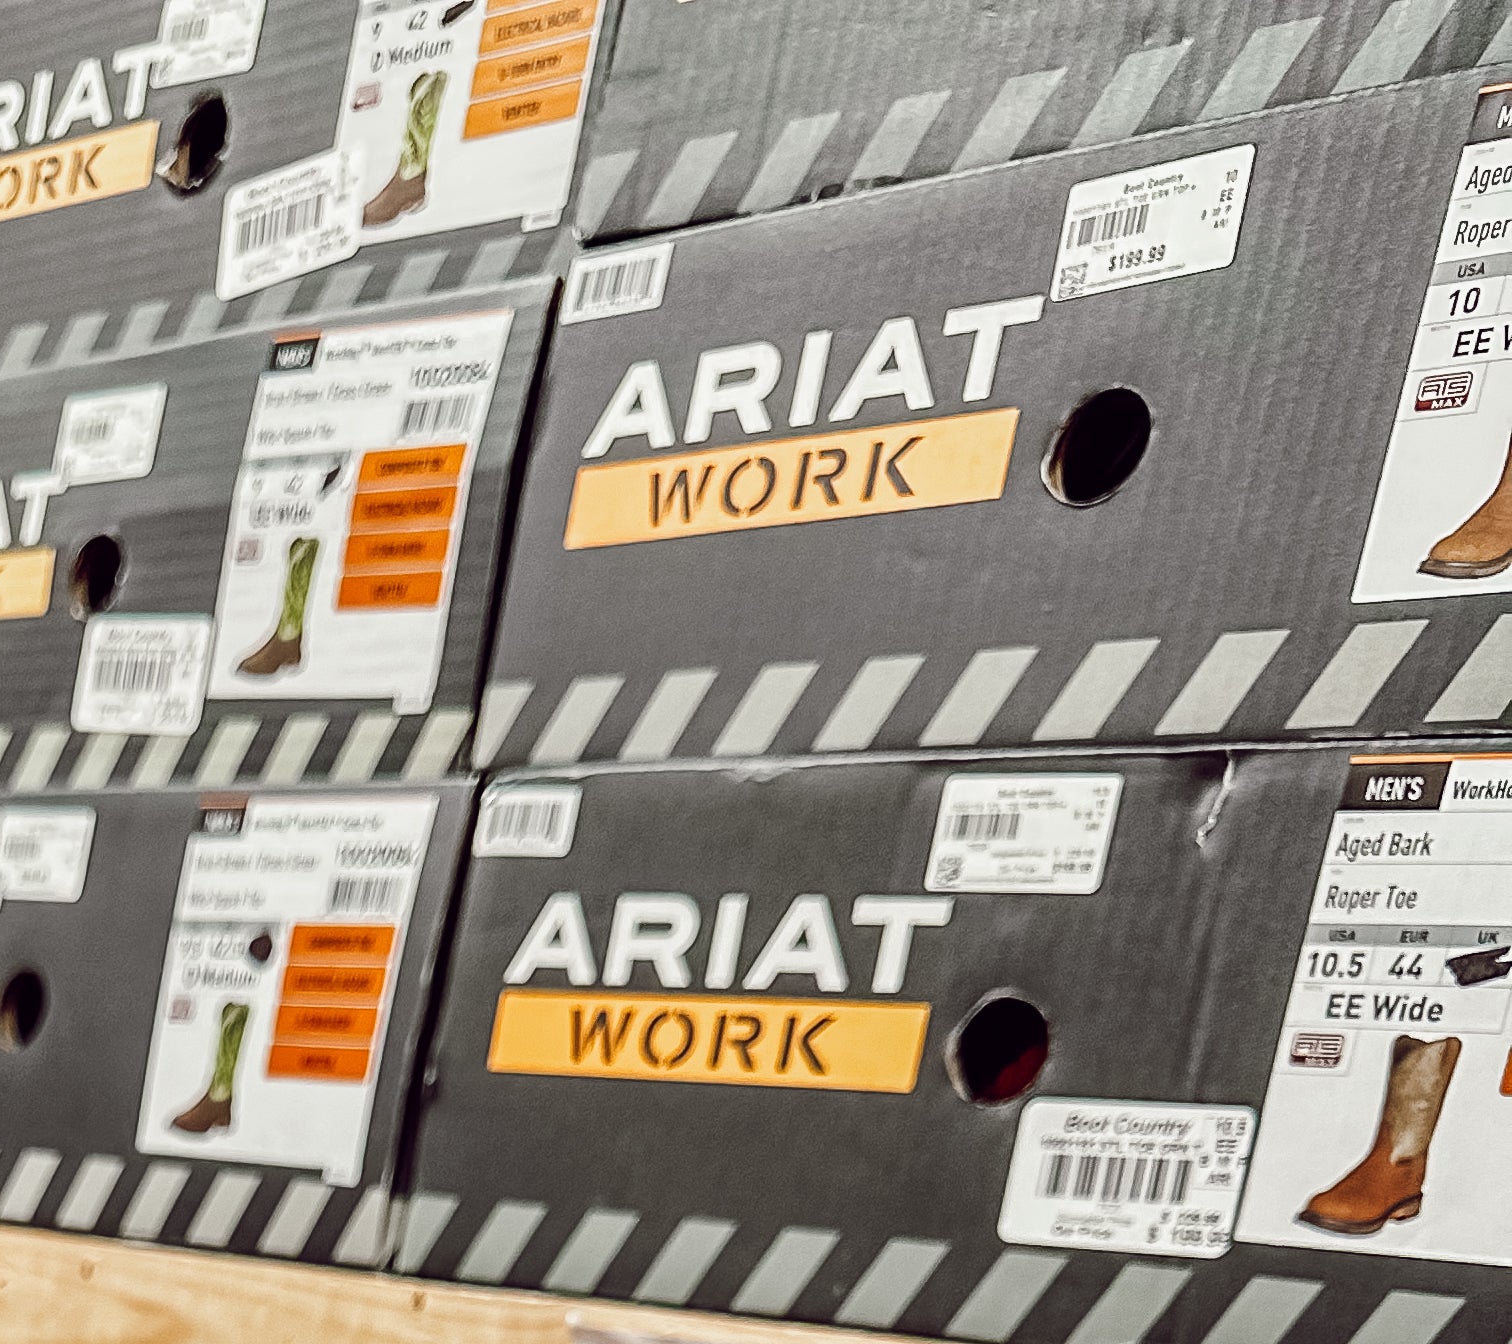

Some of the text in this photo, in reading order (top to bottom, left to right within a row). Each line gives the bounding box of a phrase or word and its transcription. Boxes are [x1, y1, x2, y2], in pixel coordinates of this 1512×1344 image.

[1108, 244, 1166, 272] $199.99
[1457, 262, 1486, 280] USA
[1449, 287, 1481, 317] 10
[1452, 327, 1495, 358] EE
[581, 295, 1047, 459] ARIAT
[649, 435, 927, 529] WORK
[1364, 775, 1425, 802] MEN'S
[1335, 831, 1434, 862] Aged Bark
[1325, 885, 1418, 915] Roper Toe
[503, 892, 956, 994] ARIAT
[1399, 930, 1430, 943] EUR
[1477, 930, 1501, 944] UK
[1308, 951, 1424, 980] 10.5 44
[1325, 993, 1444, 1022] EE Wide
[570, 1006, 837, 1076] WORK
[1064, 1110, 1109, 1133] Boot
[1115, 1112, 1191, 1136] Country
